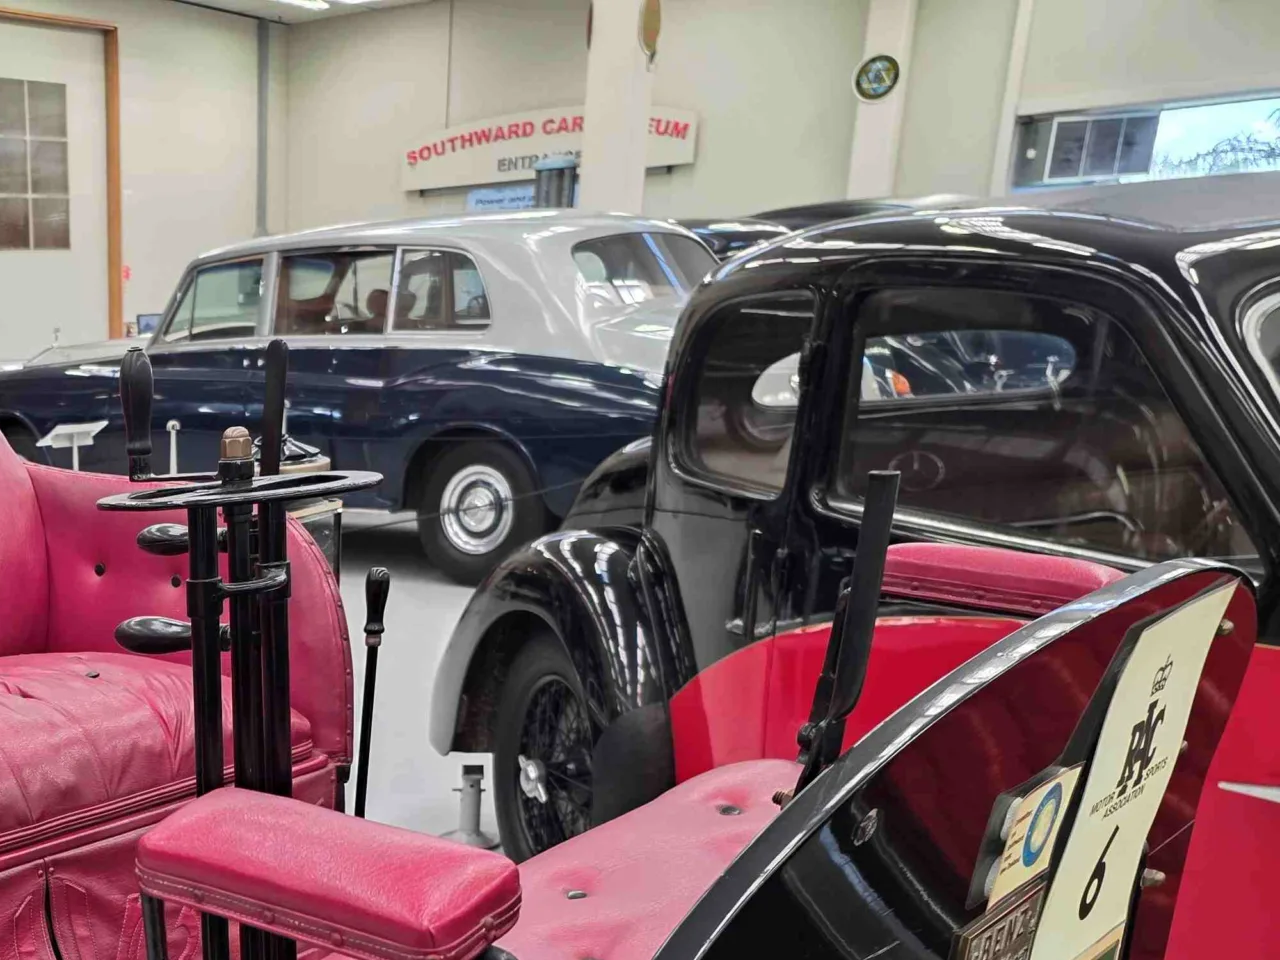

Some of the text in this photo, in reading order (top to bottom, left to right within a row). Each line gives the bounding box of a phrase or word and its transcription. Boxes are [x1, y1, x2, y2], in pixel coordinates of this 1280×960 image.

[406, 121, 535, 168] SOUTHWARD
[541, 115, 584, 136] CAR
[1089, 756, 1169, 816] MOTOR SPORTS
[1102, 784, 1146, 820] ASSOCIATION
[1078, 824, 1120, 921] 6
